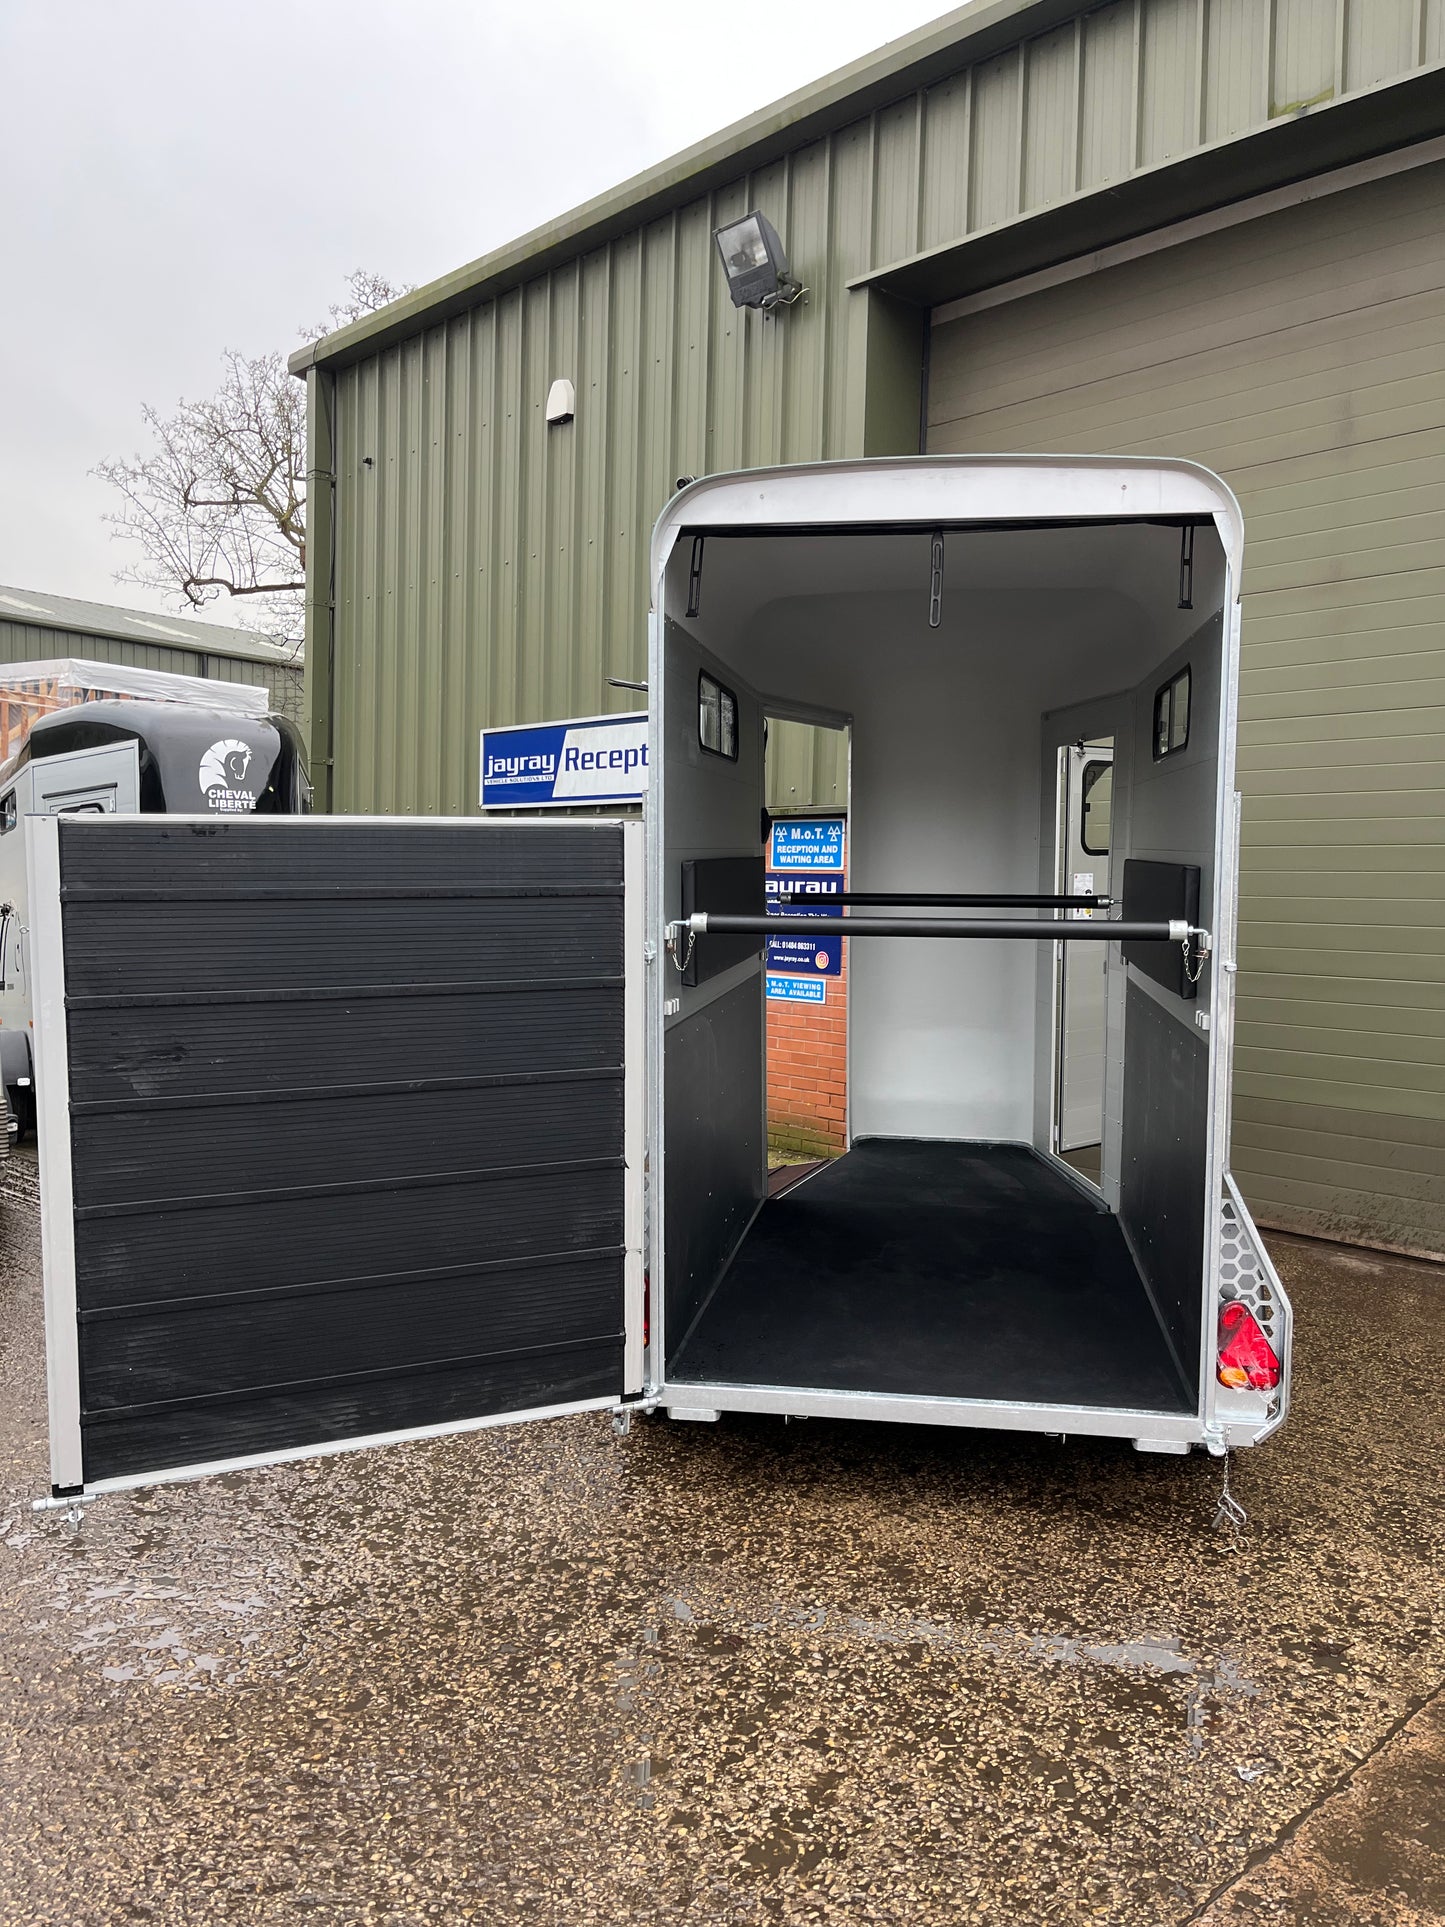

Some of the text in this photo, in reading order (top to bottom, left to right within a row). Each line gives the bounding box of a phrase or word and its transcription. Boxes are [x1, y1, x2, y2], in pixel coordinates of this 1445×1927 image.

[484, 754, 555, 778] jayray
[208, 789, 256, 800] CHEVAL
[791, 827, 824, 840] M.o.T.
[776, 845, 838, 853] RECEPTION AND
[780, 855, 834, 864] WAITING AREA
[765, 880, 837, 893] ayray
[792, 982, 821, 991] VIEWING
[788, 989, 821, 999] AVAILABLE
